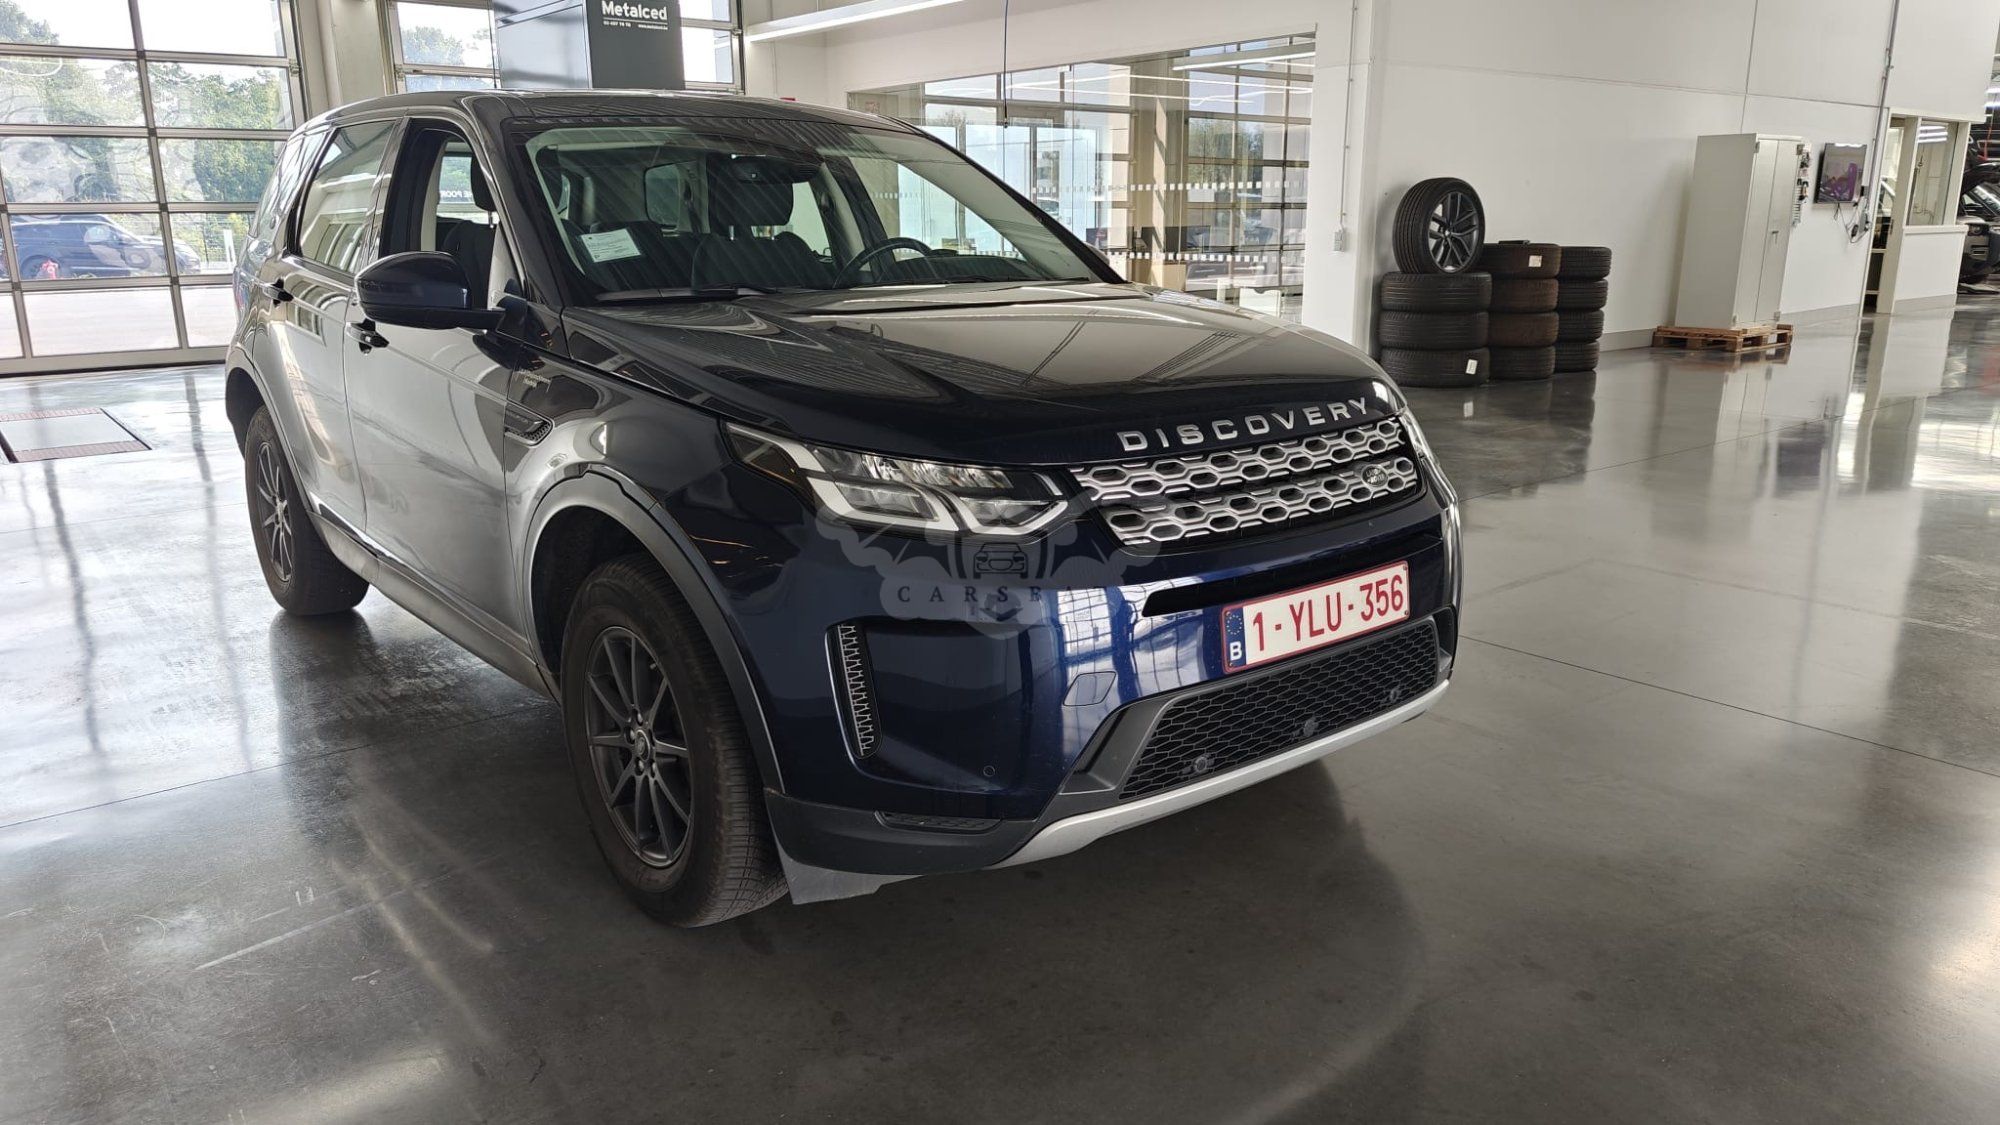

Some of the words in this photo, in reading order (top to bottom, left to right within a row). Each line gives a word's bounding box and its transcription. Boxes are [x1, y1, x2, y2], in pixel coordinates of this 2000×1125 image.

[602, 1, 668, 20] Metalced
[1117, 397, 1367, 451] DISCOVERY
[1253, 574, 1404, 652] 1-YLU-356
[1230, 641, 1243, 661] B
